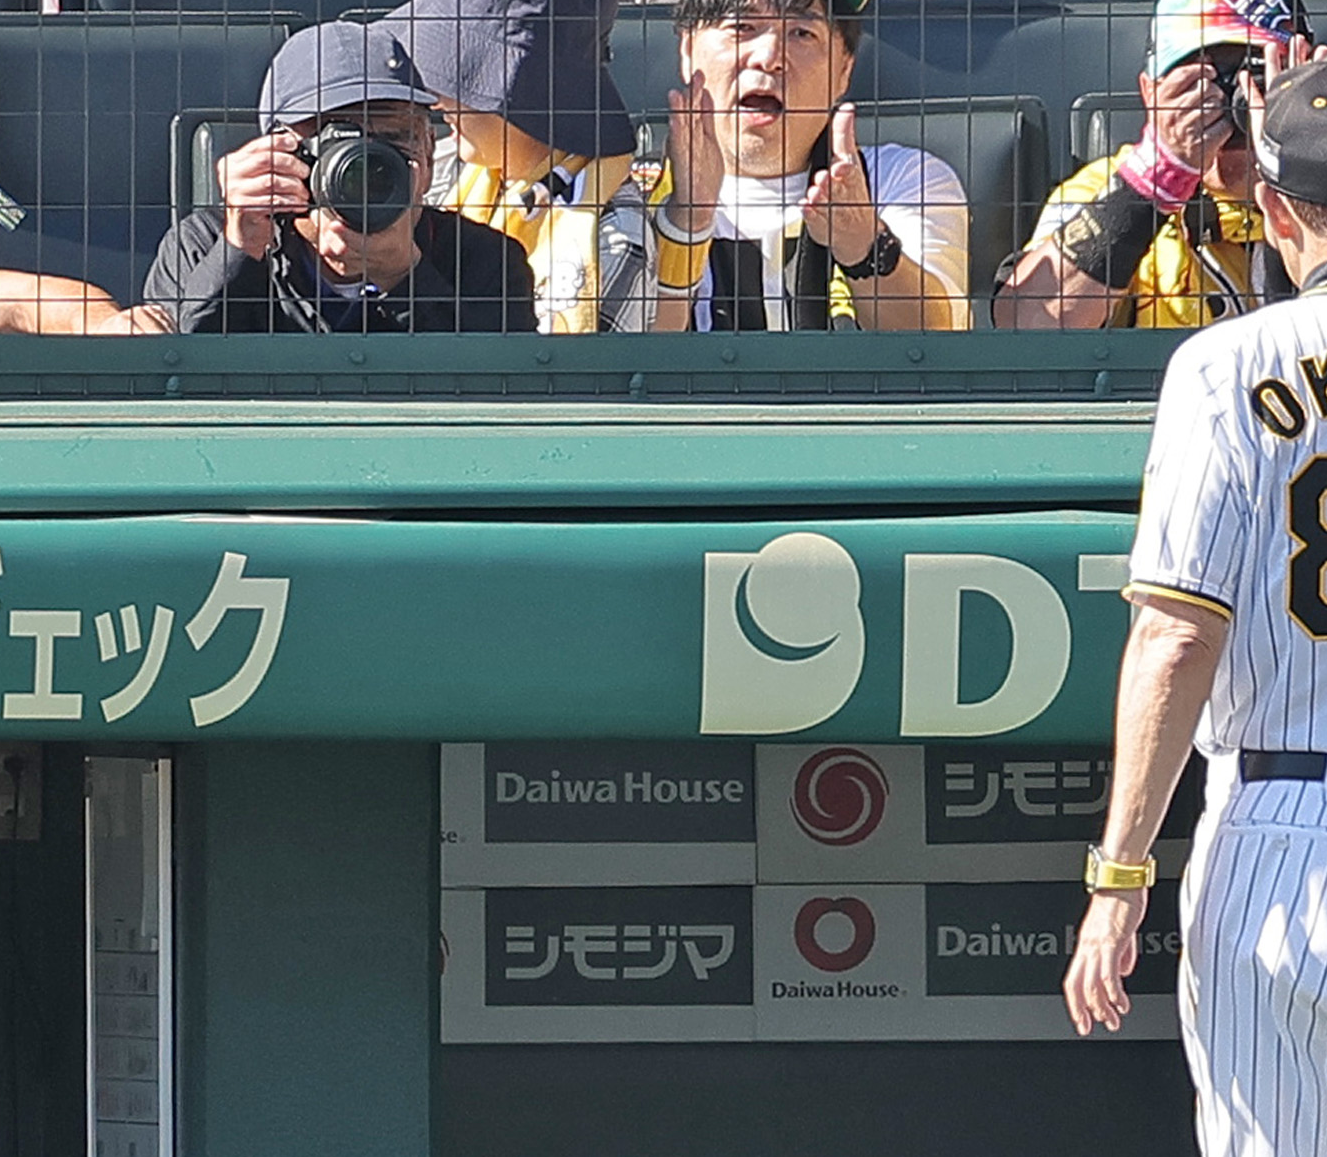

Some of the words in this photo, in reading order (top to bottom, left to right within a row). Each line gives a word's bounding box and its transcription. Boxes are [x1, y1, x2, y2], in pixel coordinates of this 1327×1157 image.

[496, 769, 617, 804] Daiwa
[624, 771, 745, 804] House
[504, 924, 736, 981] シモジマ
[936, 922, 1059, 957] Daiwa
[771, 981, 835, 999] Daiwa
[837, 981, 900, 999] House
